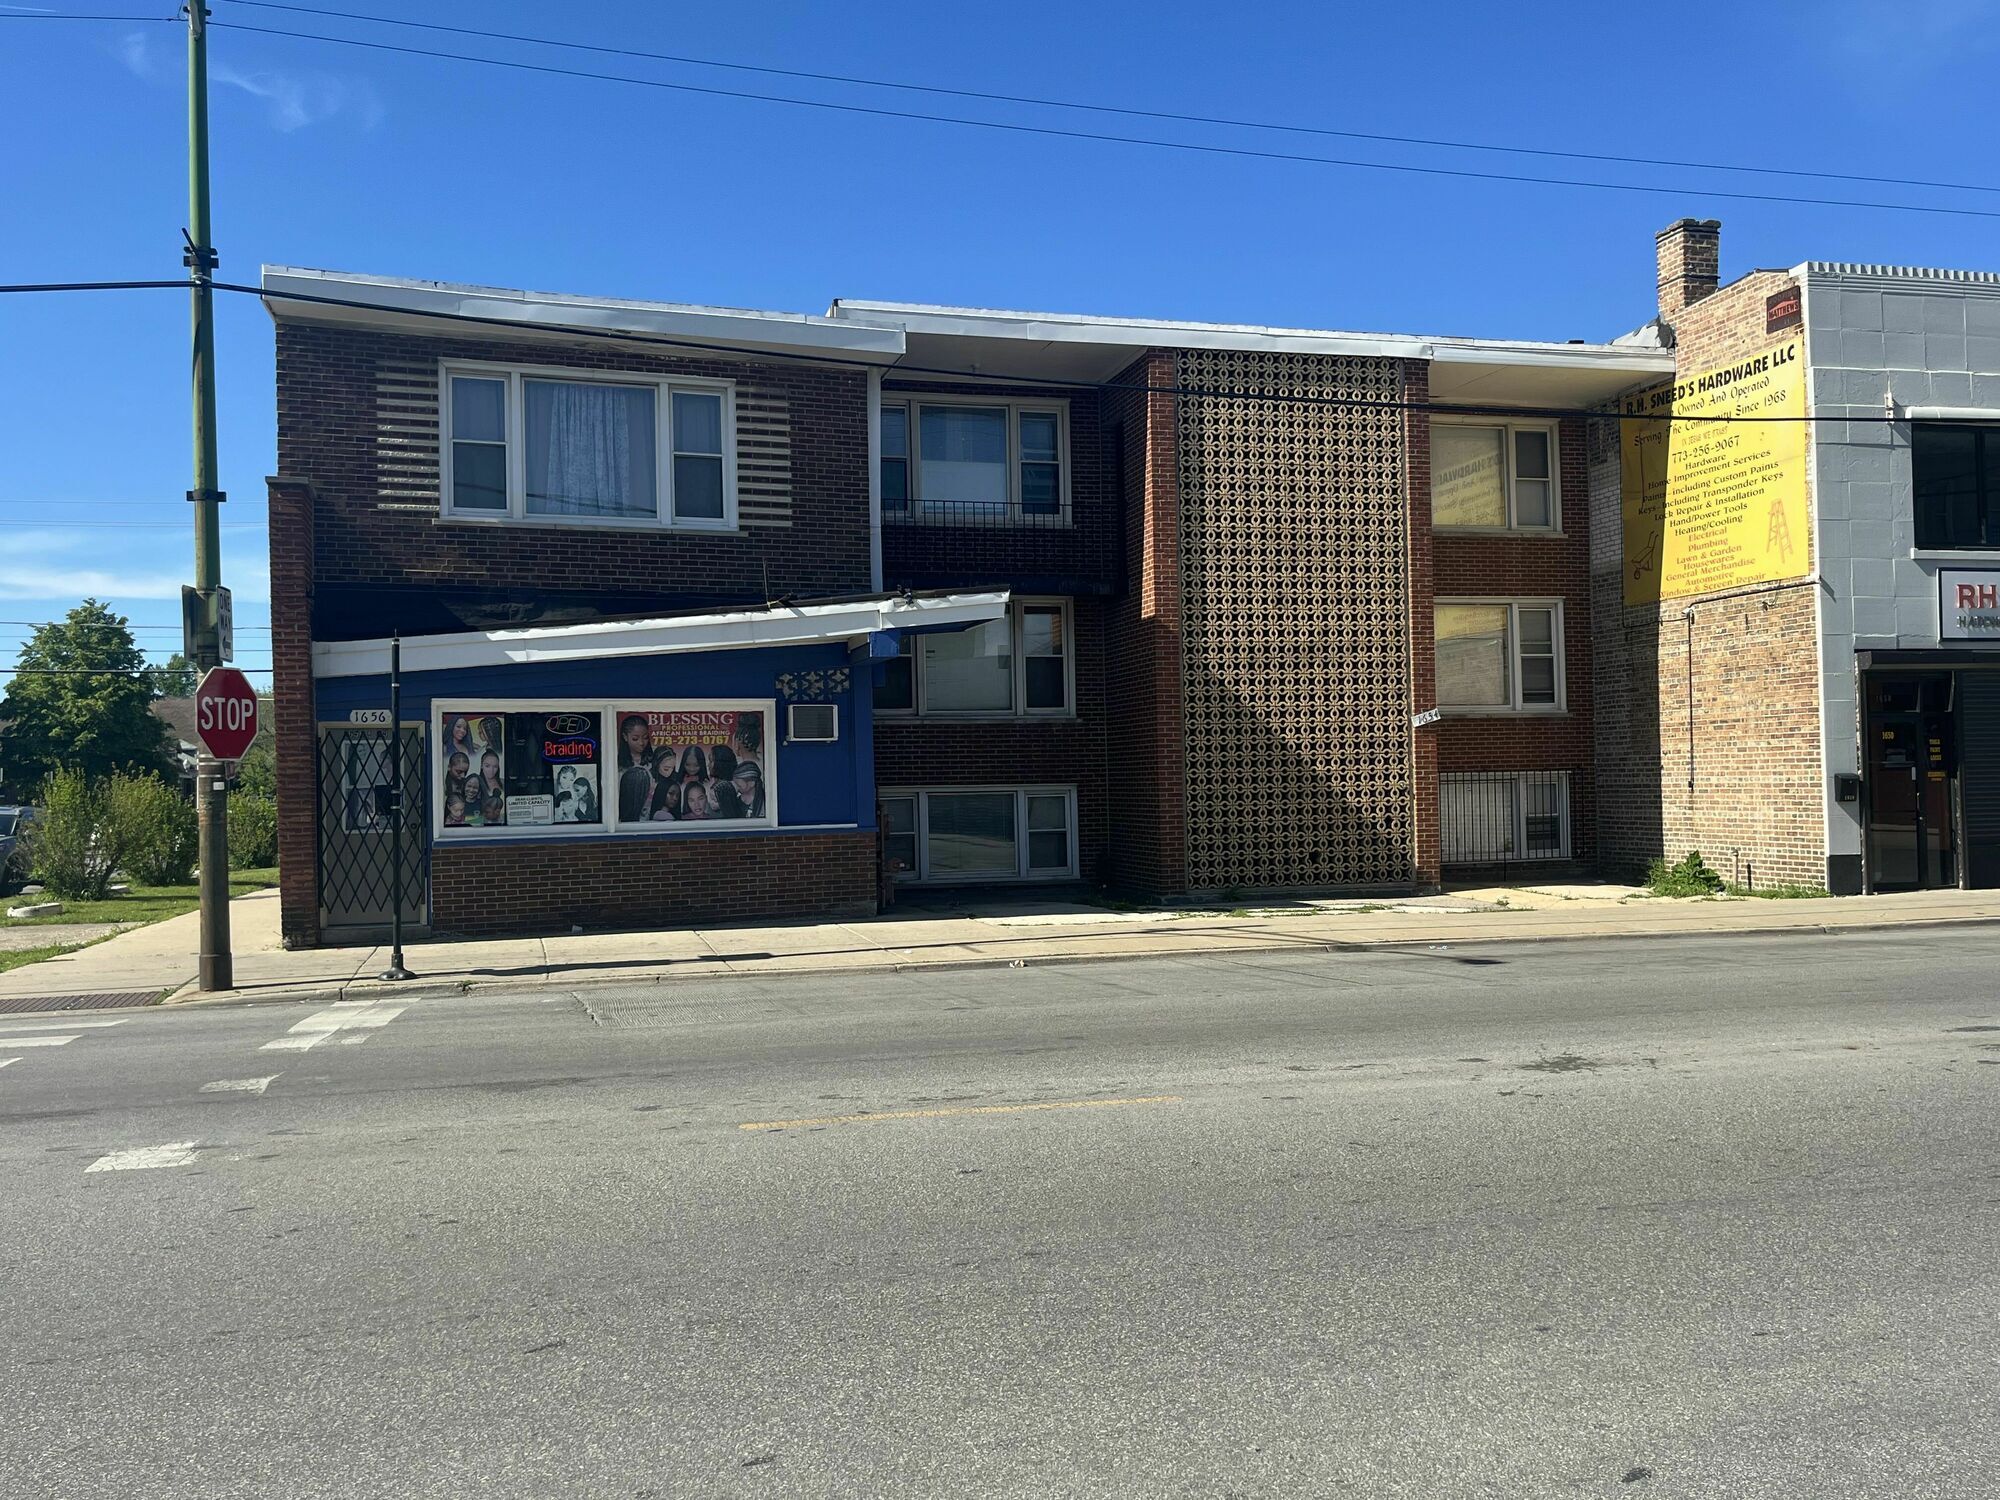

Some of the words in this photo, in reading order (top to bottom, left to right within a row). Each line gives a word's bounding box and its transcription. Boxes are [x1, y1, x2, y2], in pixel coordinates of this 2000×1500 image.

[1626, 397, 1648, 416] R.H.
[1651, 381, 1695, 409] SNEED'S
[1698, 356, 1769, 394] HARDWARE
[1773, 344, 1796, 368] LLC
[1678, 397, 1705, 415] Owned
[1710, 389, 1727, 405] And
[1730, 376, 1770, 401] Operated
[1634, 430, 1662, 447] Serving
[1735, 402, 1759, 417] Since
[1764, 389, 1787, 408] 1968
[1672, 435, 1740, 464] 773-256-9067
[1648, 477, 1671, 490] Home
[1674, 461, 1731, 482] Improvement
[1734, 449, 1771, 466] Services
[1685, 454, 1726, 470] Hardware
[1713, 470, 1747, 485] Custom
[1751, 461, 1779, 475] Paints
[1703, 478, 1757, 499] Transponder
[1761, 470, 1784, 485] Keys
[1655, 509, 1674, 521] Lock
[1676, 503, 1702, 518] Repair
[1715, 487, 1765, 506] Installation
[1670, 508, 1720, 528] Hand/Power
[1724, 502, 1748, 515] Tools
[1675, 514, 1743, 536] Heating/Cooling
[1688, 527, 1728, 542] Electrical
[1677, 554, 1698, 565] Lawn
[1700, 551, 1707, 560] &
[1710, 545, 1742, 558] Garden
[1688, 537, 1728, 553] Plumbing
[1666, 569, 1698, 582] General
[1700, 558, 1756, 575] Merchandise
[1683, 555, 1735, 571] Housewares
[1659, 587, 1691, 599] Window
[1694, 585, 1701, 593] &
[1703, 578, 1733, 591] Screen
[1736, 572, 1766, 587] Repair
[1685, 571, 1734, 587] Automotive
[220, 592, 231, 613] ONE
[1955, 584, 1997, 609] RH
[220, 614, 231, 632] WAY
[200, 696, 255, 731] STOP
[355, 711, 386, 723] 1656
[547, 715, 588, 732] OPEN
[648, 713, 734, 726] BLESSING
[545, 740, 592, 759] Braiding
[653, 736, 730, 745] 773-273-0767
